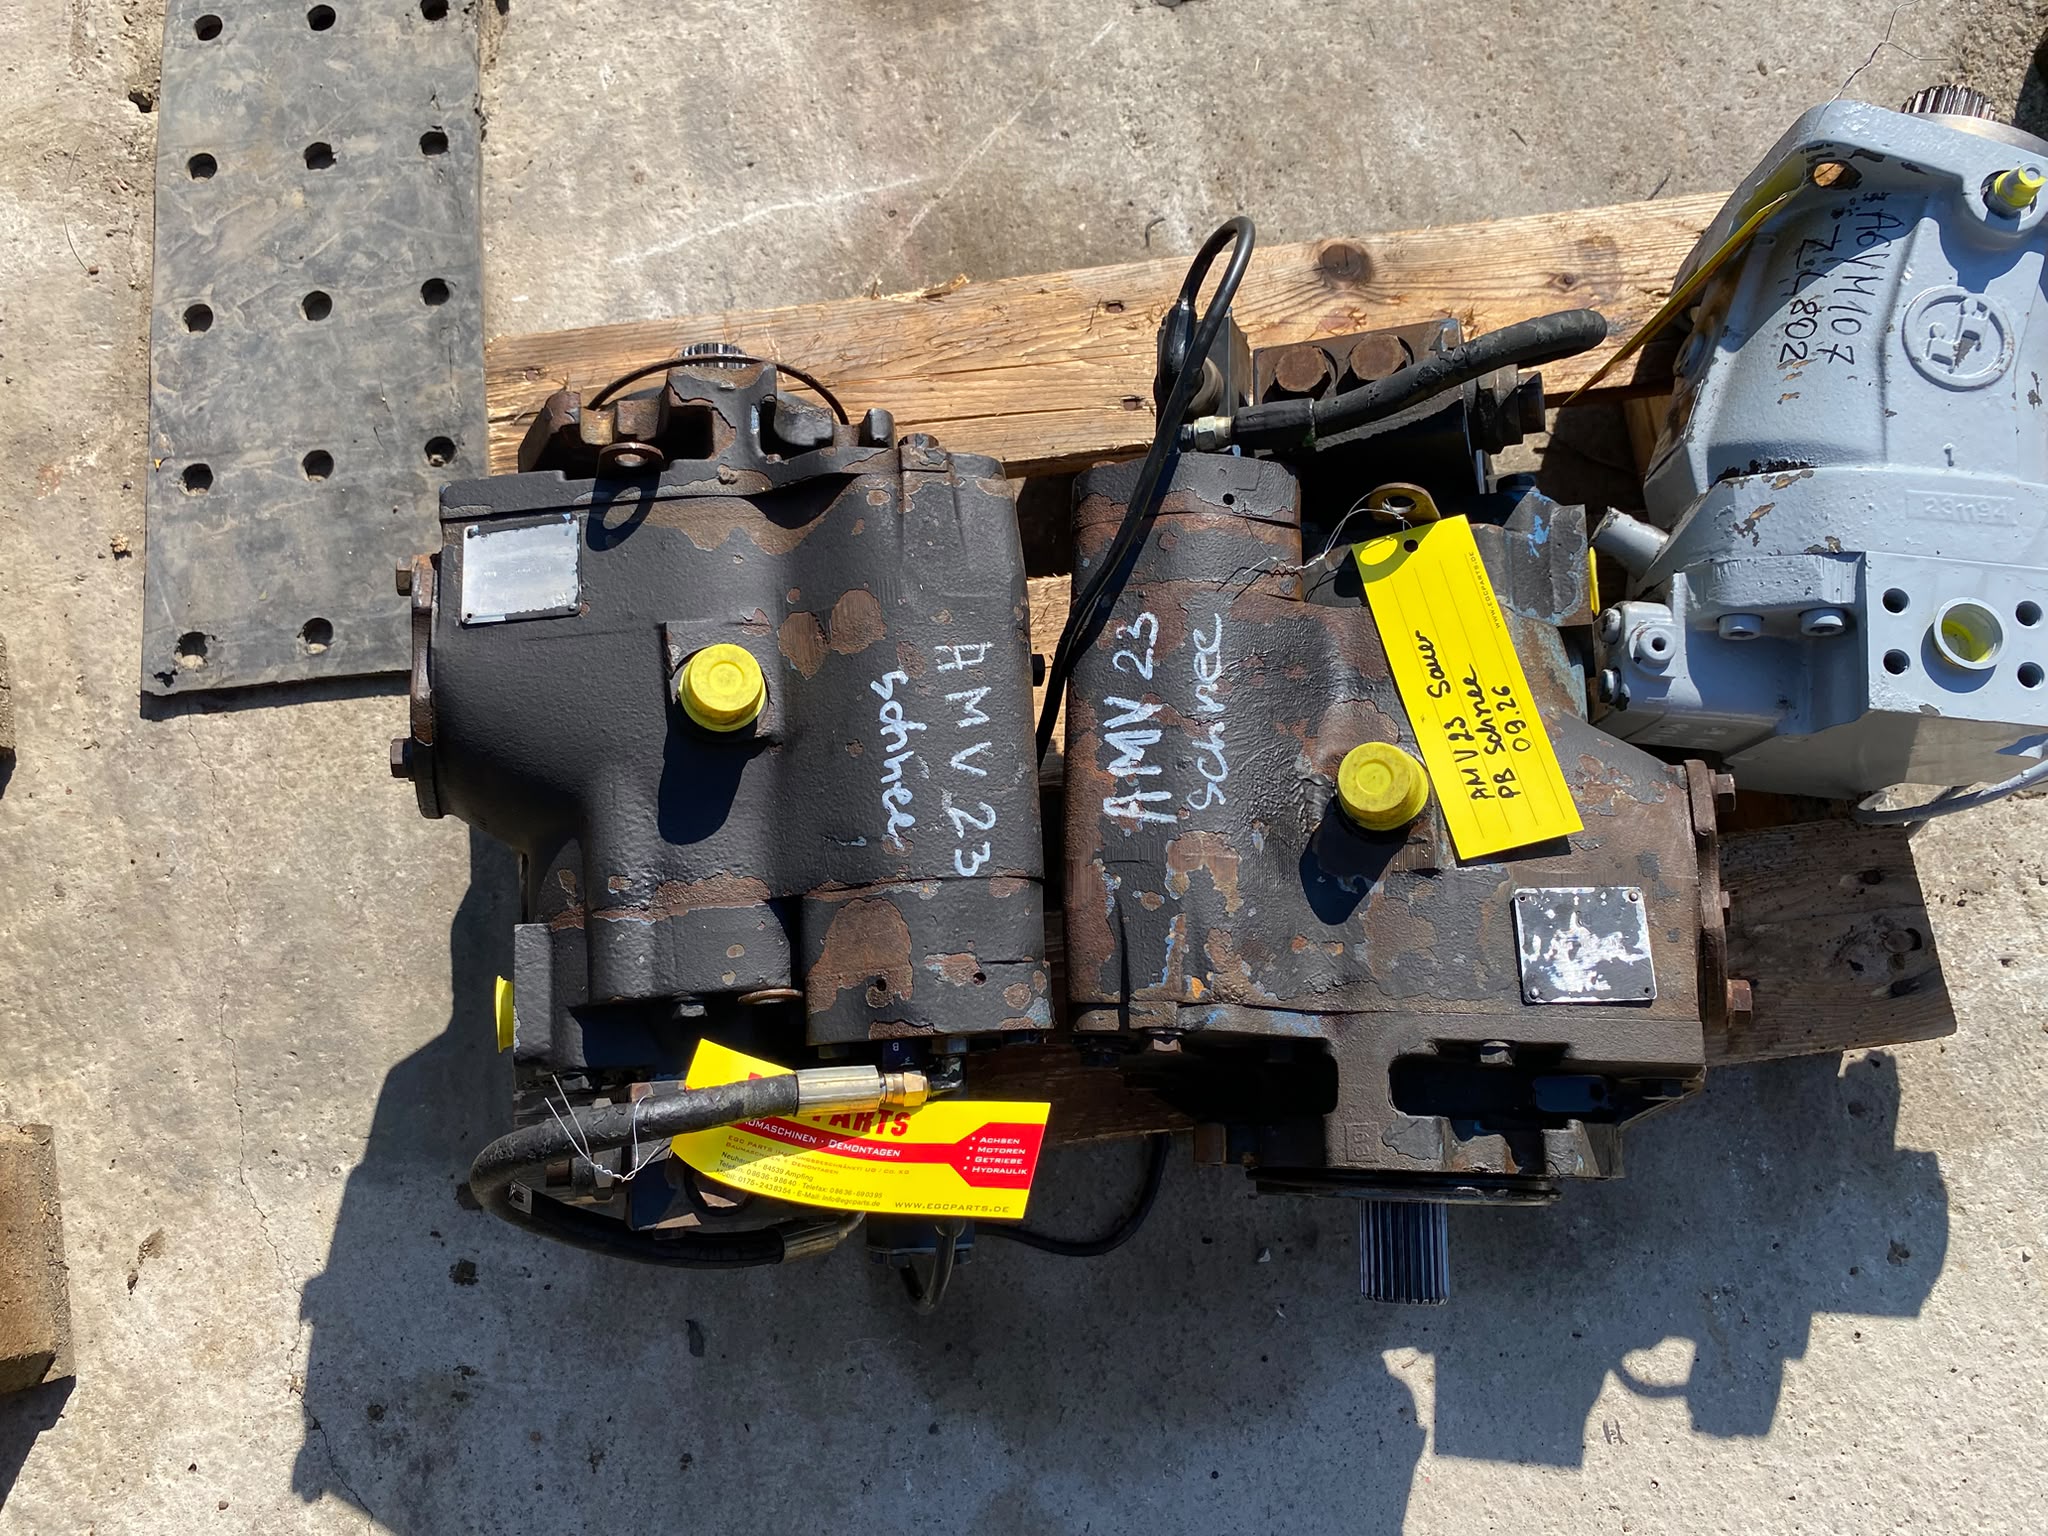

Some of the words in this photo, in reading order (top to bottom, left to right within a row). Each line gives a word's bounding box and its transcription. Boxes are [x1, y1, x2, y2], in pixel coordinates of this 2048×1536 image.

[1111, 611, 1160, 681] 23
[1414, 629, 1452, 700] Sauer
[1461, 662, 1506, 756] Schnee
[1491, 684, 1532, 752] 09.26
[1443, 715, 1468, 743] 23
[1493, 766, 1522, 800] PB
[944, 801, 997, 878] 23
[744, 1116, 818, 1145] UMASCHINEN
[828, 1138, 901, 1157] DEMONTAGEN
[811, 1107, 912, 1138] ARTS
[977, 1146, 1026, 1155] MOTOREN
[979, 1136, 1021, 1145] ACHSEN
[762, 1164, 784, 1175] 84539
[784, 1169, 815, 1183] Ampfing
[971, 1165, 1028, 1175] HYDRAULIK
[974, 1156, 1024, 1165] GETRIEBE
[894, 1201, 1010, 1213] WWW.EGCPARTS.DE
